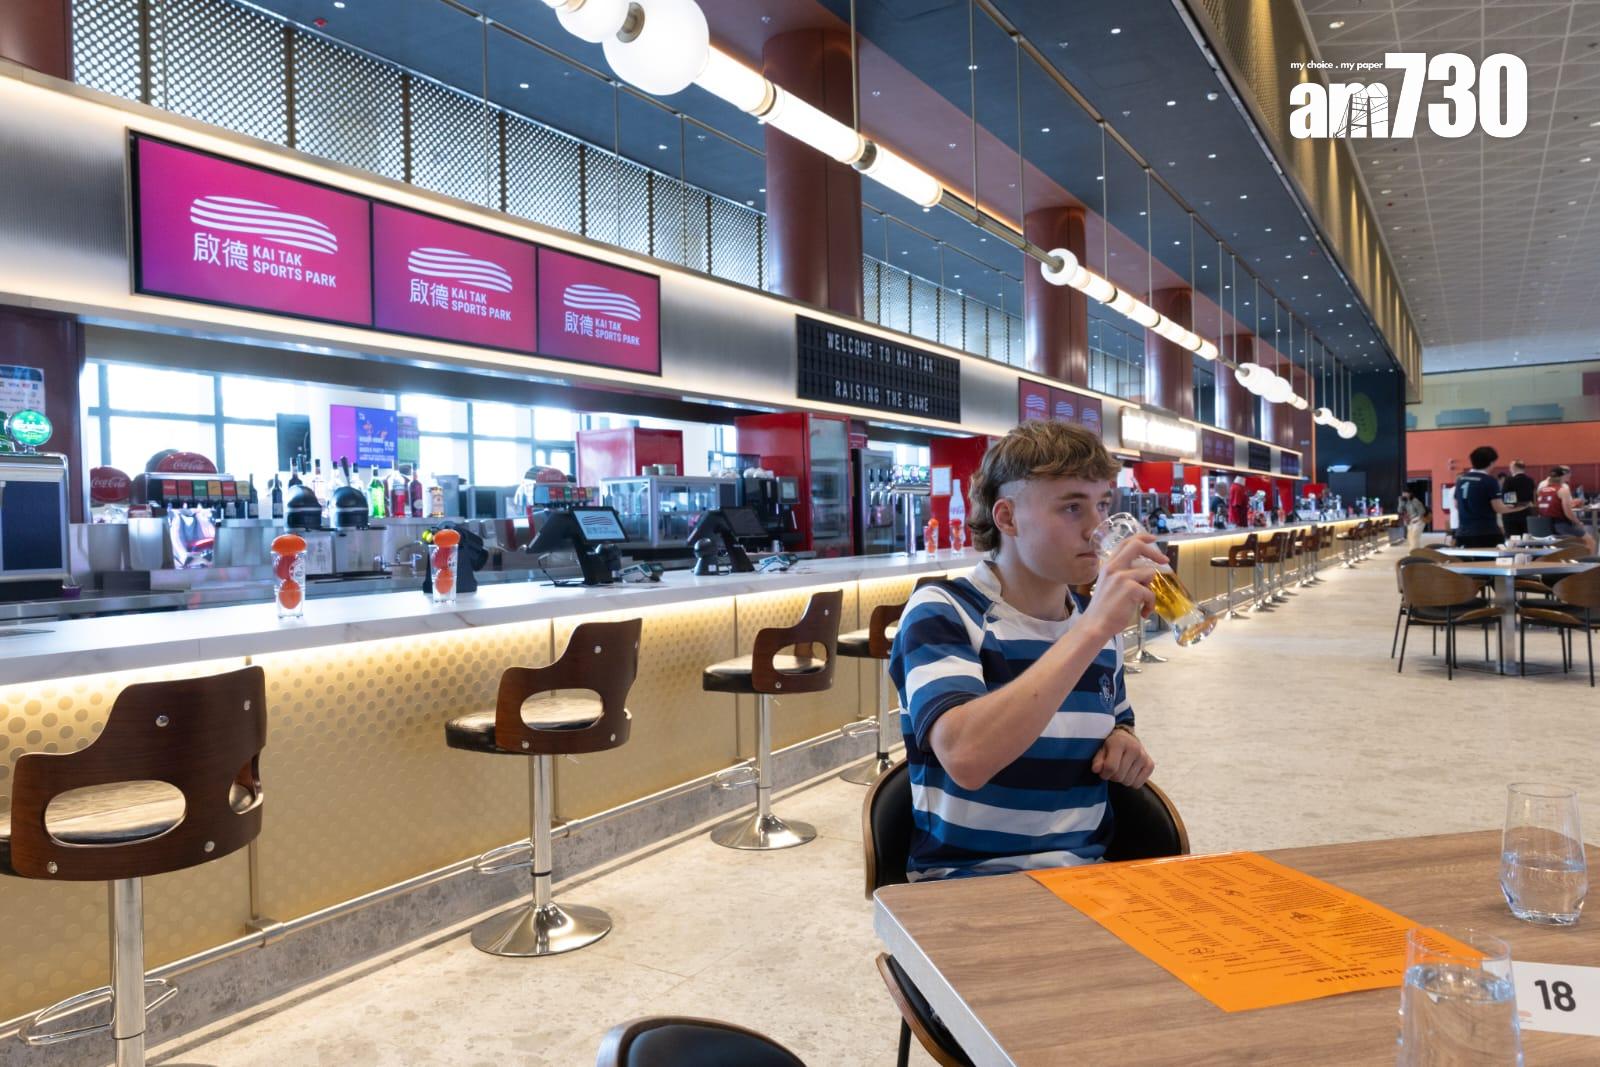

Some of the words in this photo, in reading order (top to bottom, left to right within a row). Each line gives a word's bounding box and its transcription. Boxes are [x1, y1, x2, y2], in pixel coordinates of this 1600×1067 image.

[193, 232, 249, 271] 啟德
[253, 245, 275, 261] KAI
[278, 250, 302, 266] TAK
[253, 260, 302, 281] SPORTS
[305, 270, 336, 288] PARK
[410, 278, 448, 309] 啟德
[451, 287, 468, 300] KAI
[470, 291, 487, 305] TAK
[451, 300, 487, 317] SPORTS
[489, 307, 512, 321] PARK
[564, 311, 594, 337] 啟德
[595, 317, 607, 329] KAI
[608, 320, 622, 332] TAK
[595, 328, 621, 342] SPORTS
[622, 334, 640, 346] PARK
[827, 331, 872, 358] WELCOME
[879, 345, 890, 363] TO
[919, 355, 934, 373] TAK
[835, 380, 880, 403] RAISING
[886, 390, 902, 407] THE
[908, 394, 929, 412] GAME
[1460, 481, 1470, 499] 1
[1534, 979, 1576, 1012] 18
